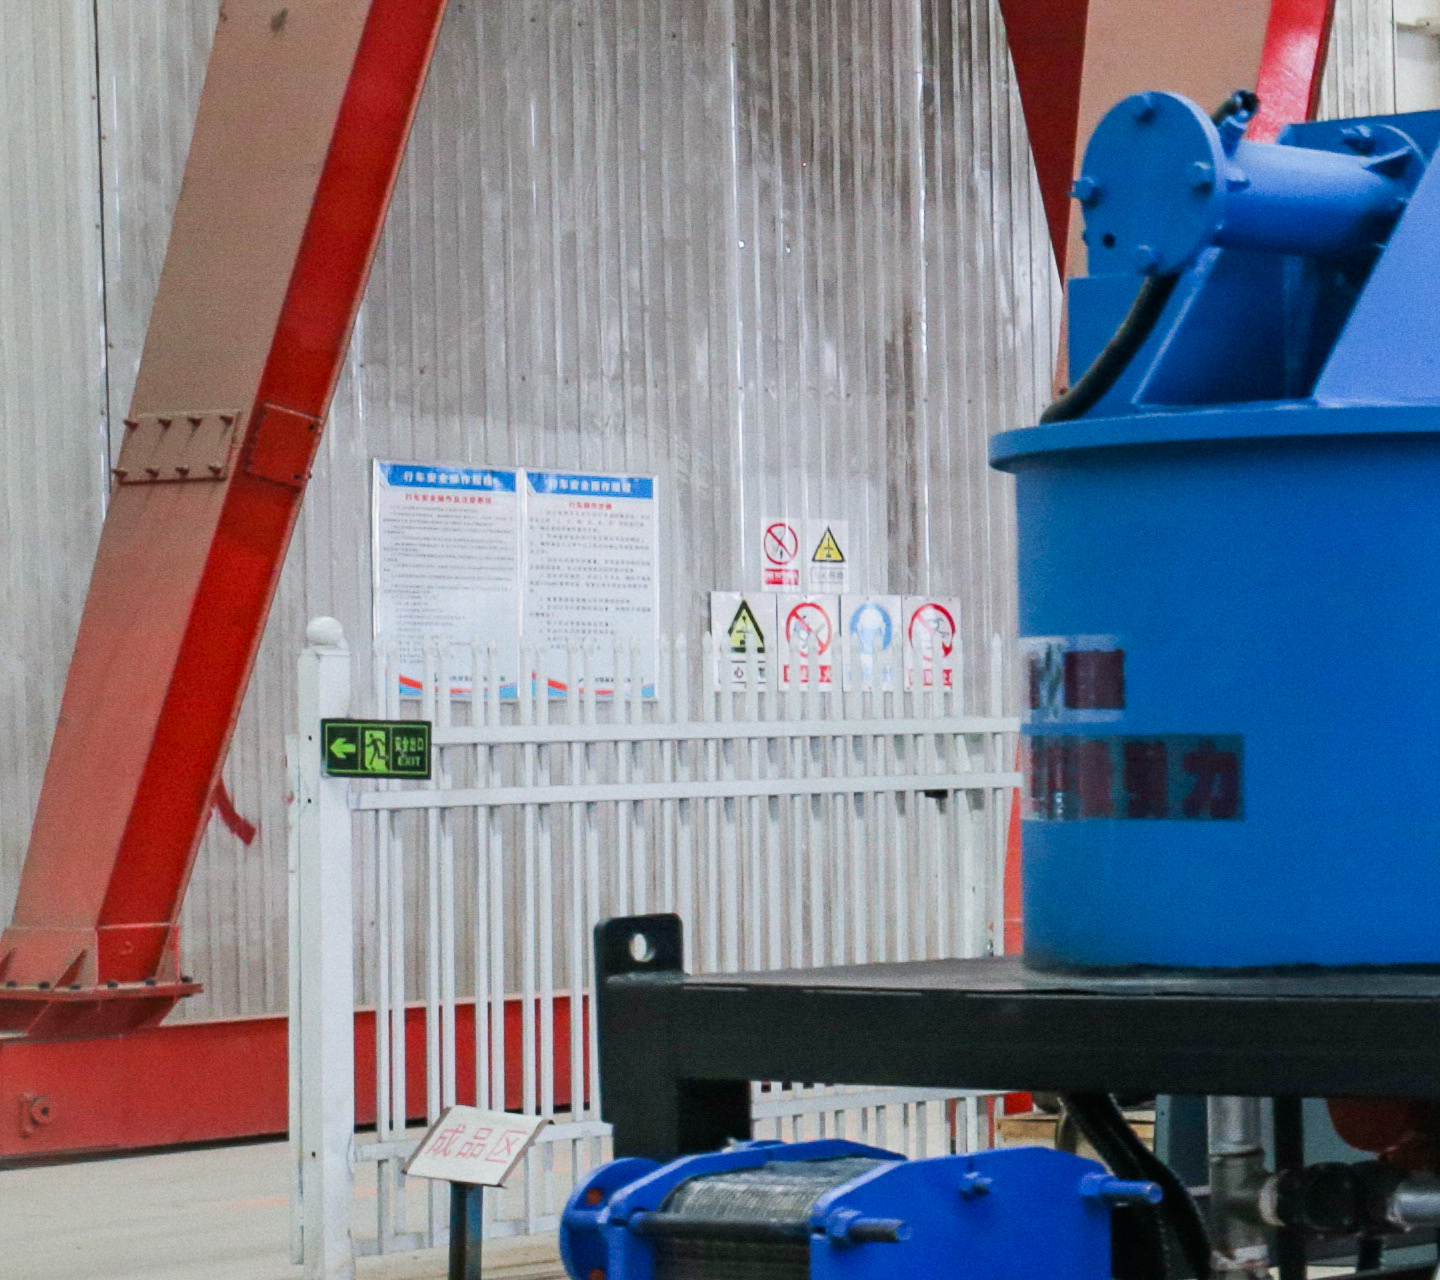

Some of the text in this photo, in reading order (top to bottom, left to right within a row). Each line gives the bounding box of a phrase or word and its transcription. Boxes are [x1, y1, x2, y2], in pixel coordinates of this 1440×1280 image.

[397, 755, 420, 767] EXIT
[424, 1123, 528, 1164] 成品区
